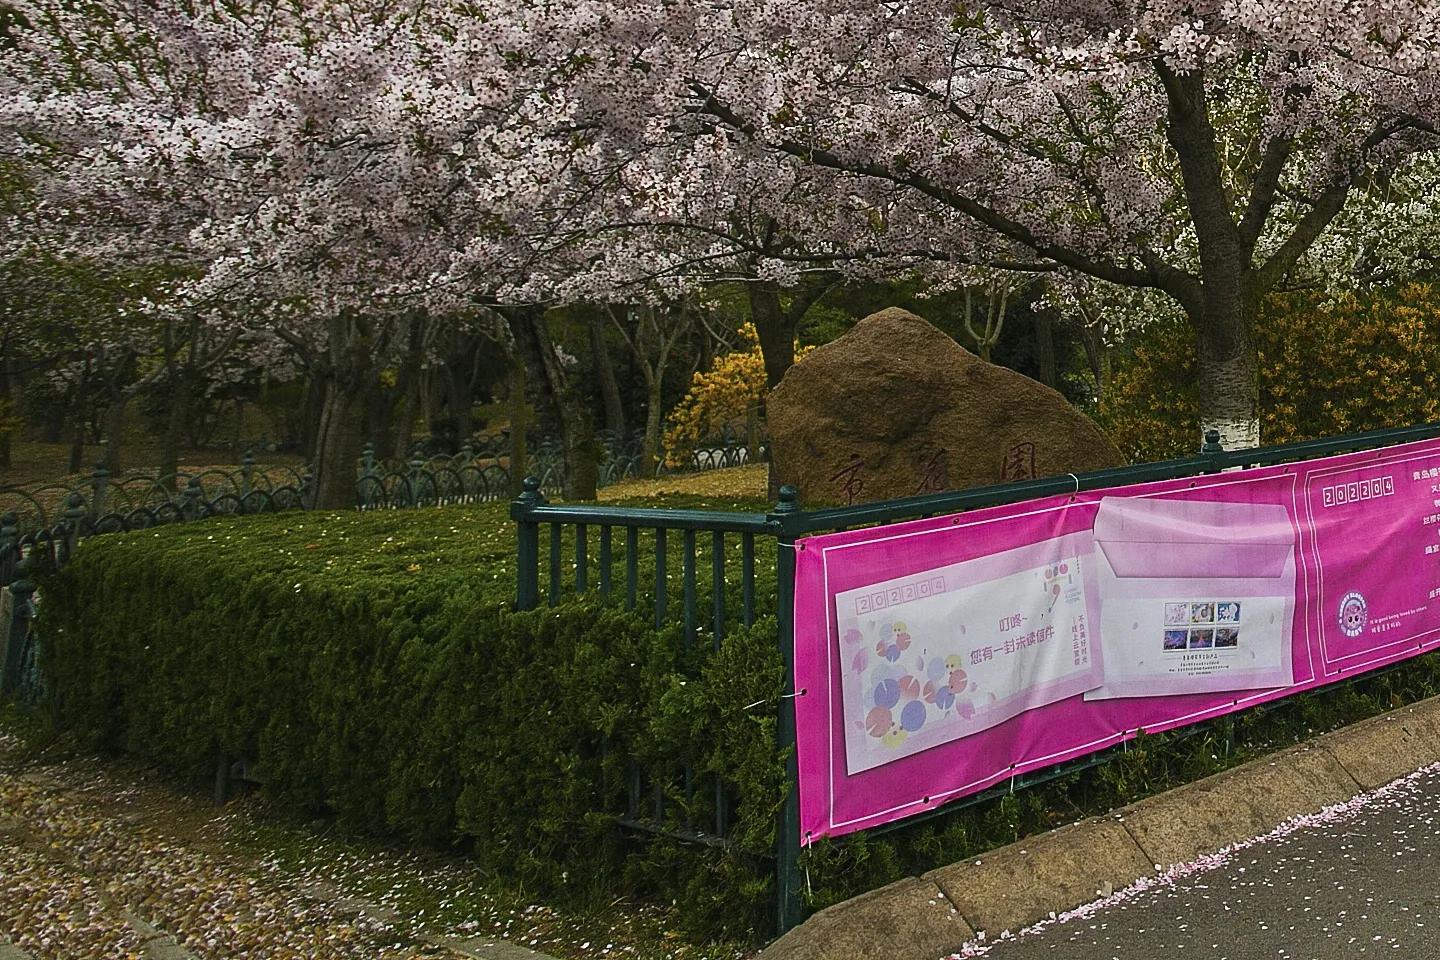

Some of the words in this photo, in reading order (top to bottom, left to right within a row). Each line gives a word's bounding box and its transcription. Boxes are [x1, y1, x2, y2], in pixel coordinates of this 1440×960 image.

[1326, 480, 1392, 503] 202204
[860, 581, 943, 610] 202204
[970, 624, 1055, 665] 您有一封未读信件
